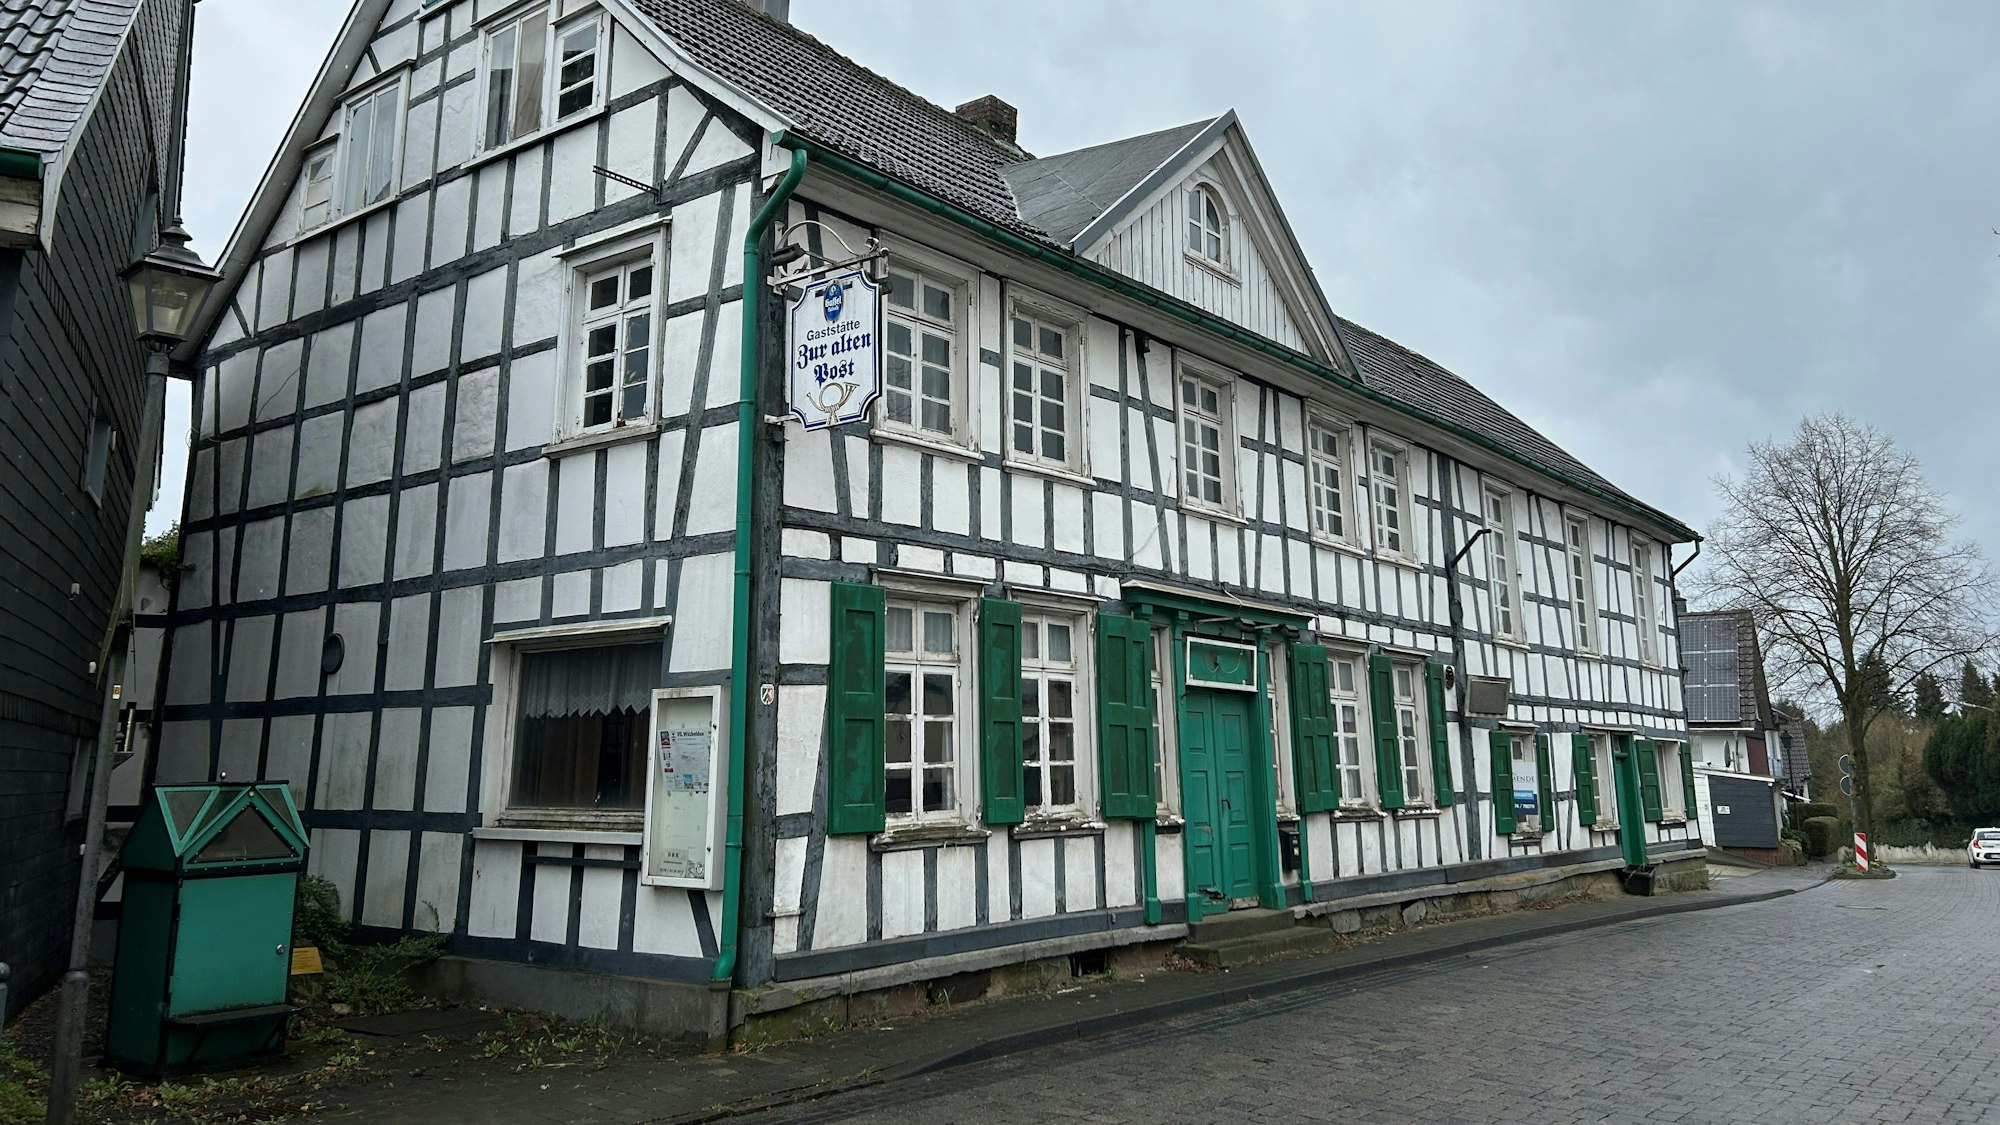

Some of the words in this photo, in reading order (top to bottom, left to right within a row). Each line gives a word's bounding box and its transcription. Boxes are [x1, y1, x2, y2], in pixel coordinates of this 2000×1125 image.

[806, 320, 860, 342] Gaststätte
[796, 343, 828, 370] Zur
[831, 332, 872, 357] alten
[813, 359, 855, 389] Post
